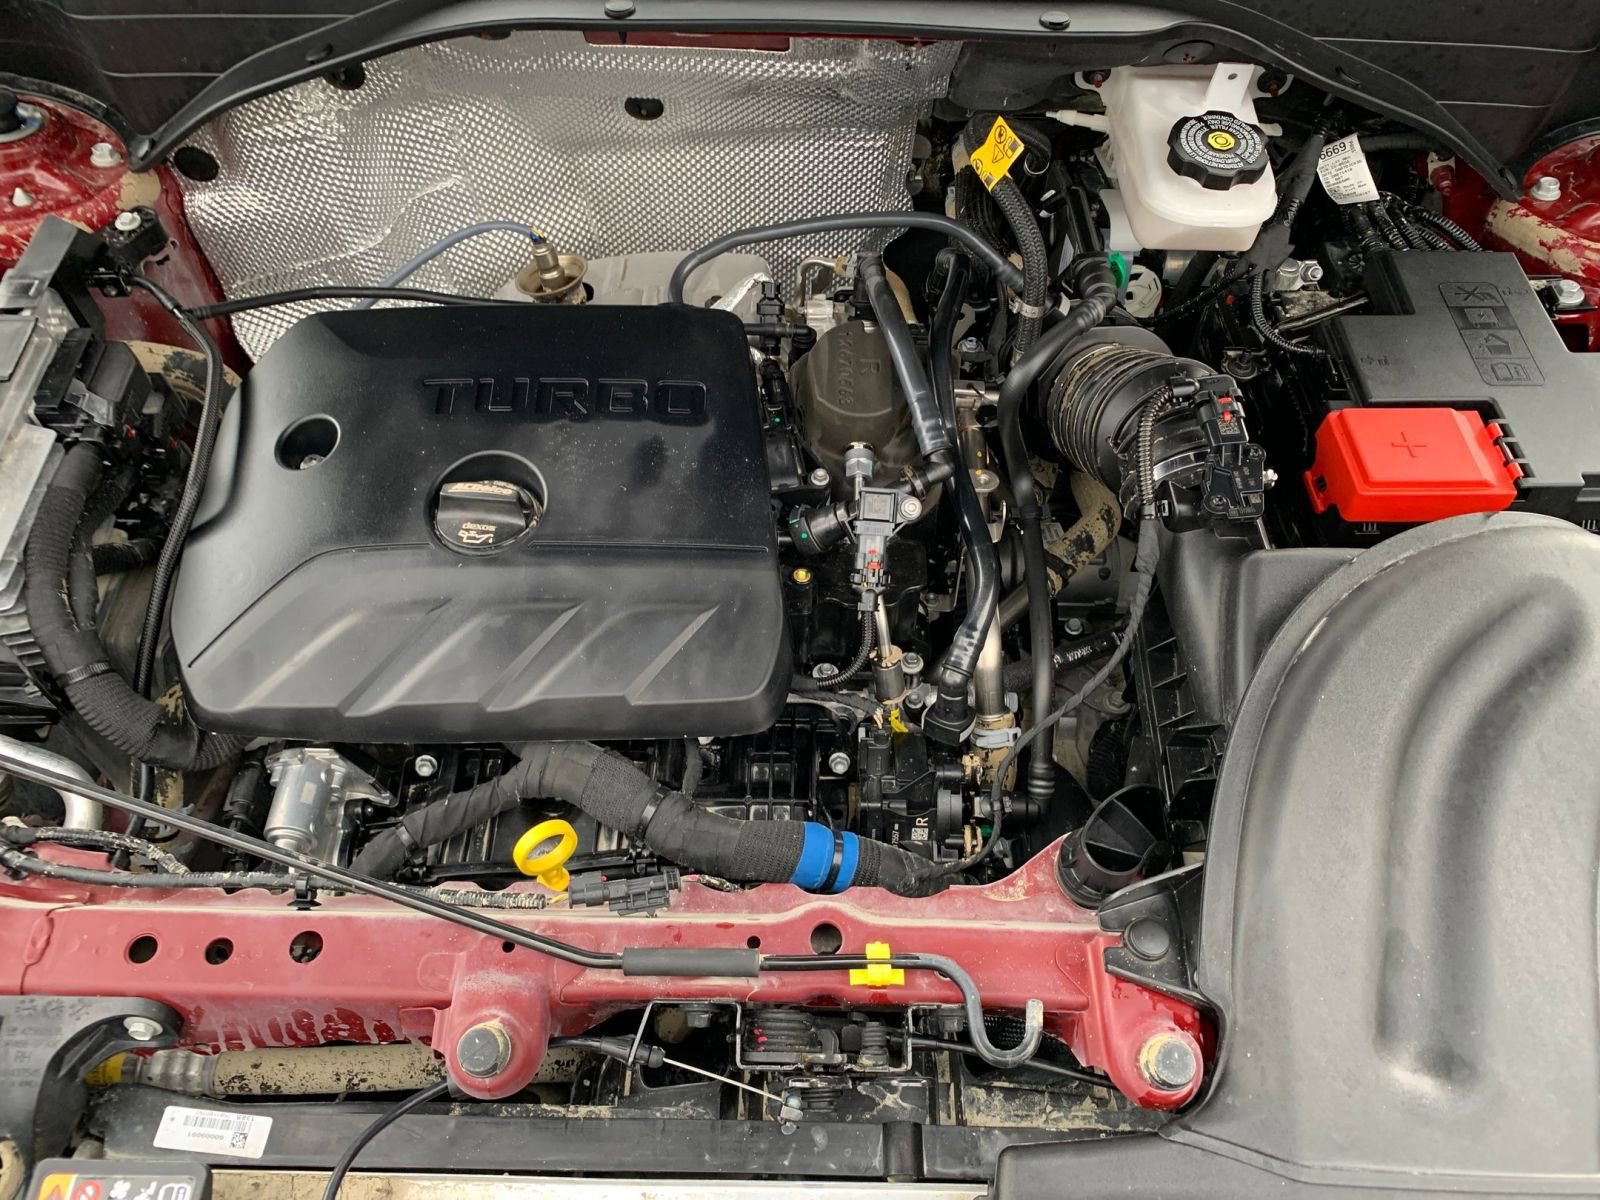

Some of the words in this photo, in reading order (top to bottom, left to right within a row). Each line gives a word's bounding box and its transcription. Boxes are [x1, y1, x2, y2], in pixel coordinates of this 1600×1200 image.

[423, 377, 708, 416] TURBO
[462, 521, 497, 532] dexos
[915, 817, 929, 826] R
